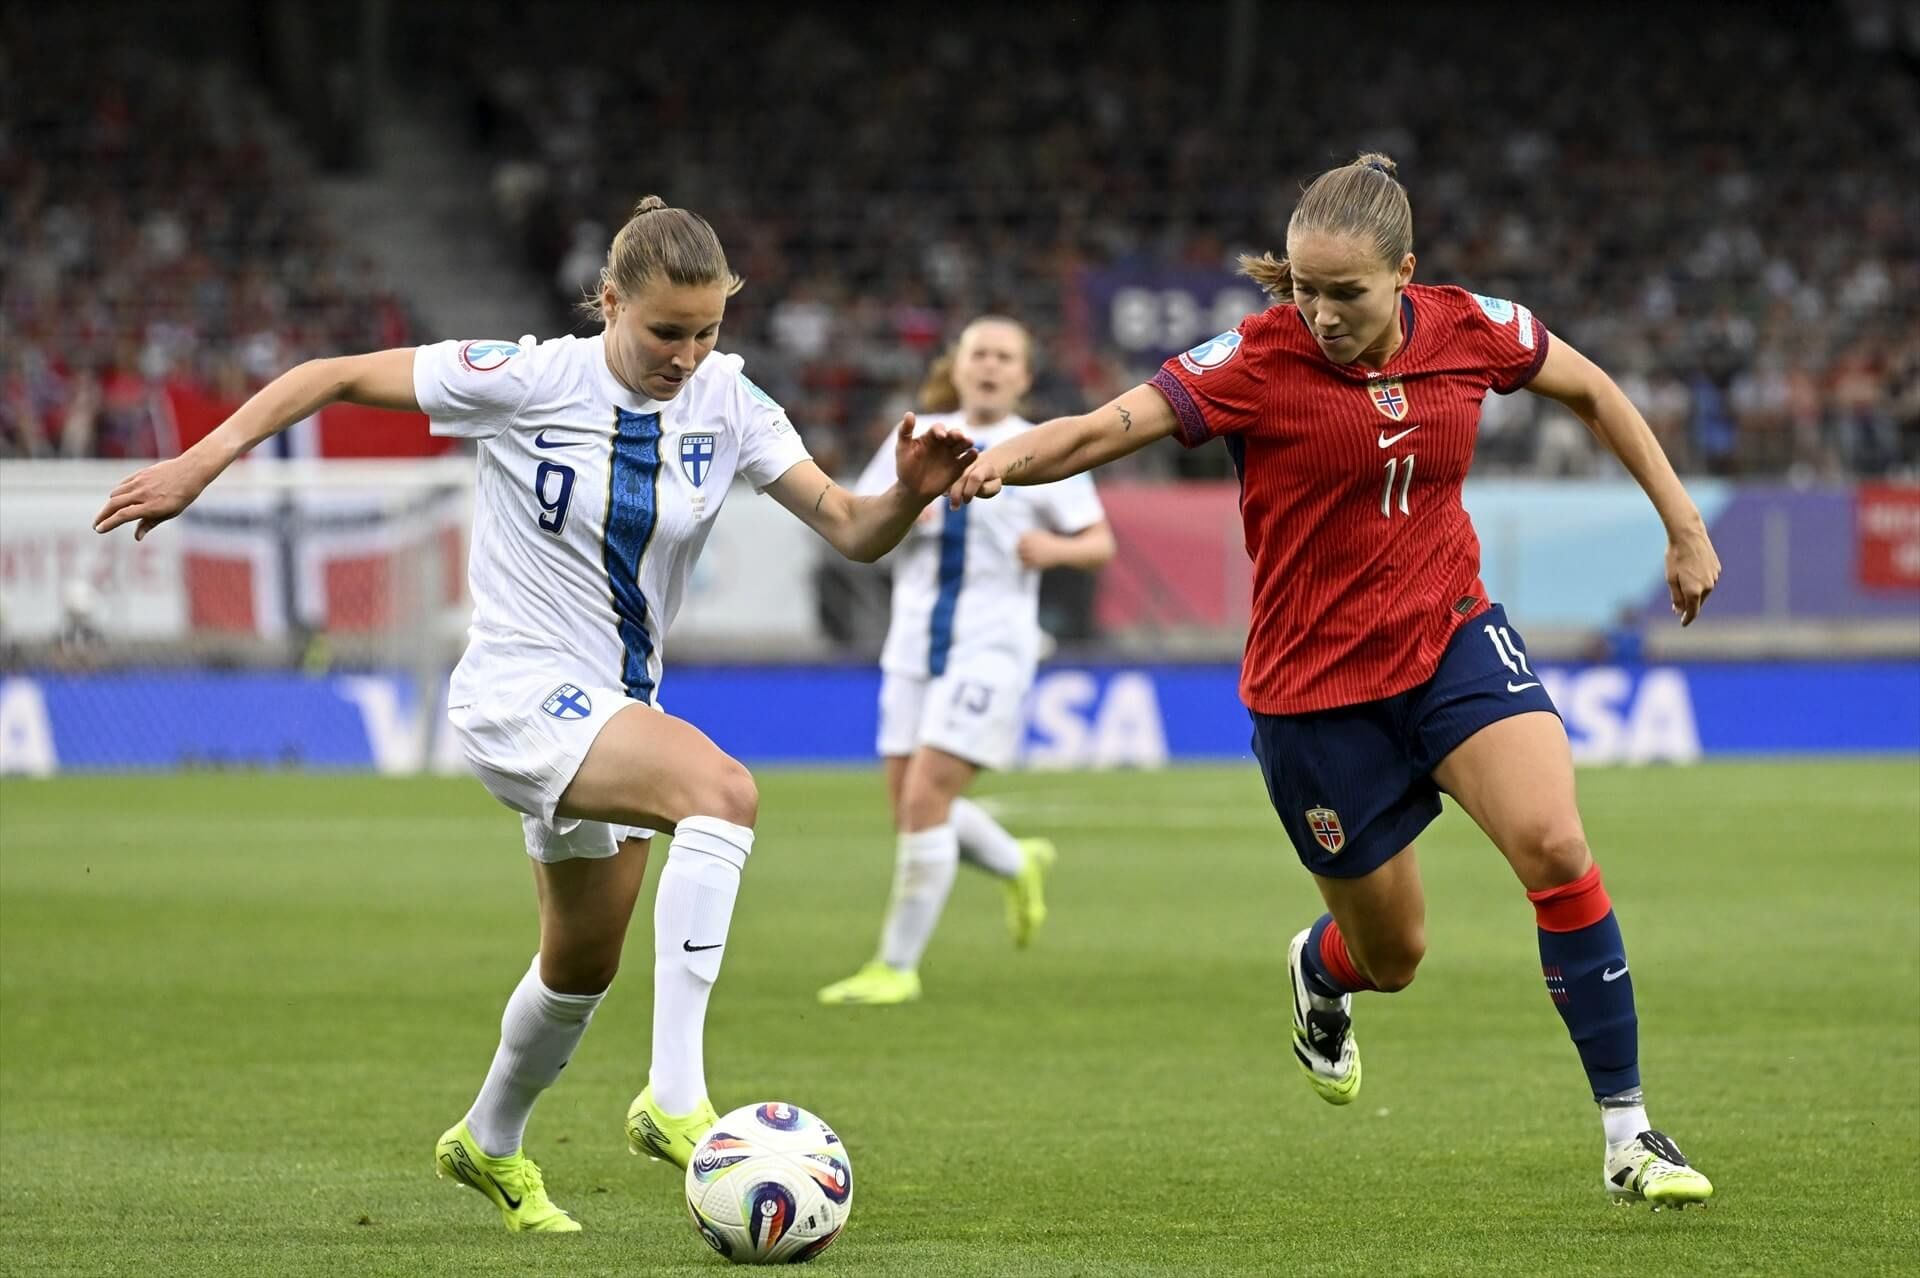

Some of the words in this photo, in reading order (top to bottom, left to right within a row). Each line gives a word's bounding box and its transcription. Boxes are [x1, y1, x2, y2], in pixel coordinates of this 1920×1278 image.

[535, 461, 577, 535] 9
[1381, 454, 1415, 518] 11
[1484, 624, 1533, 677] 11
[1022, 668, 1171, 767] SA
